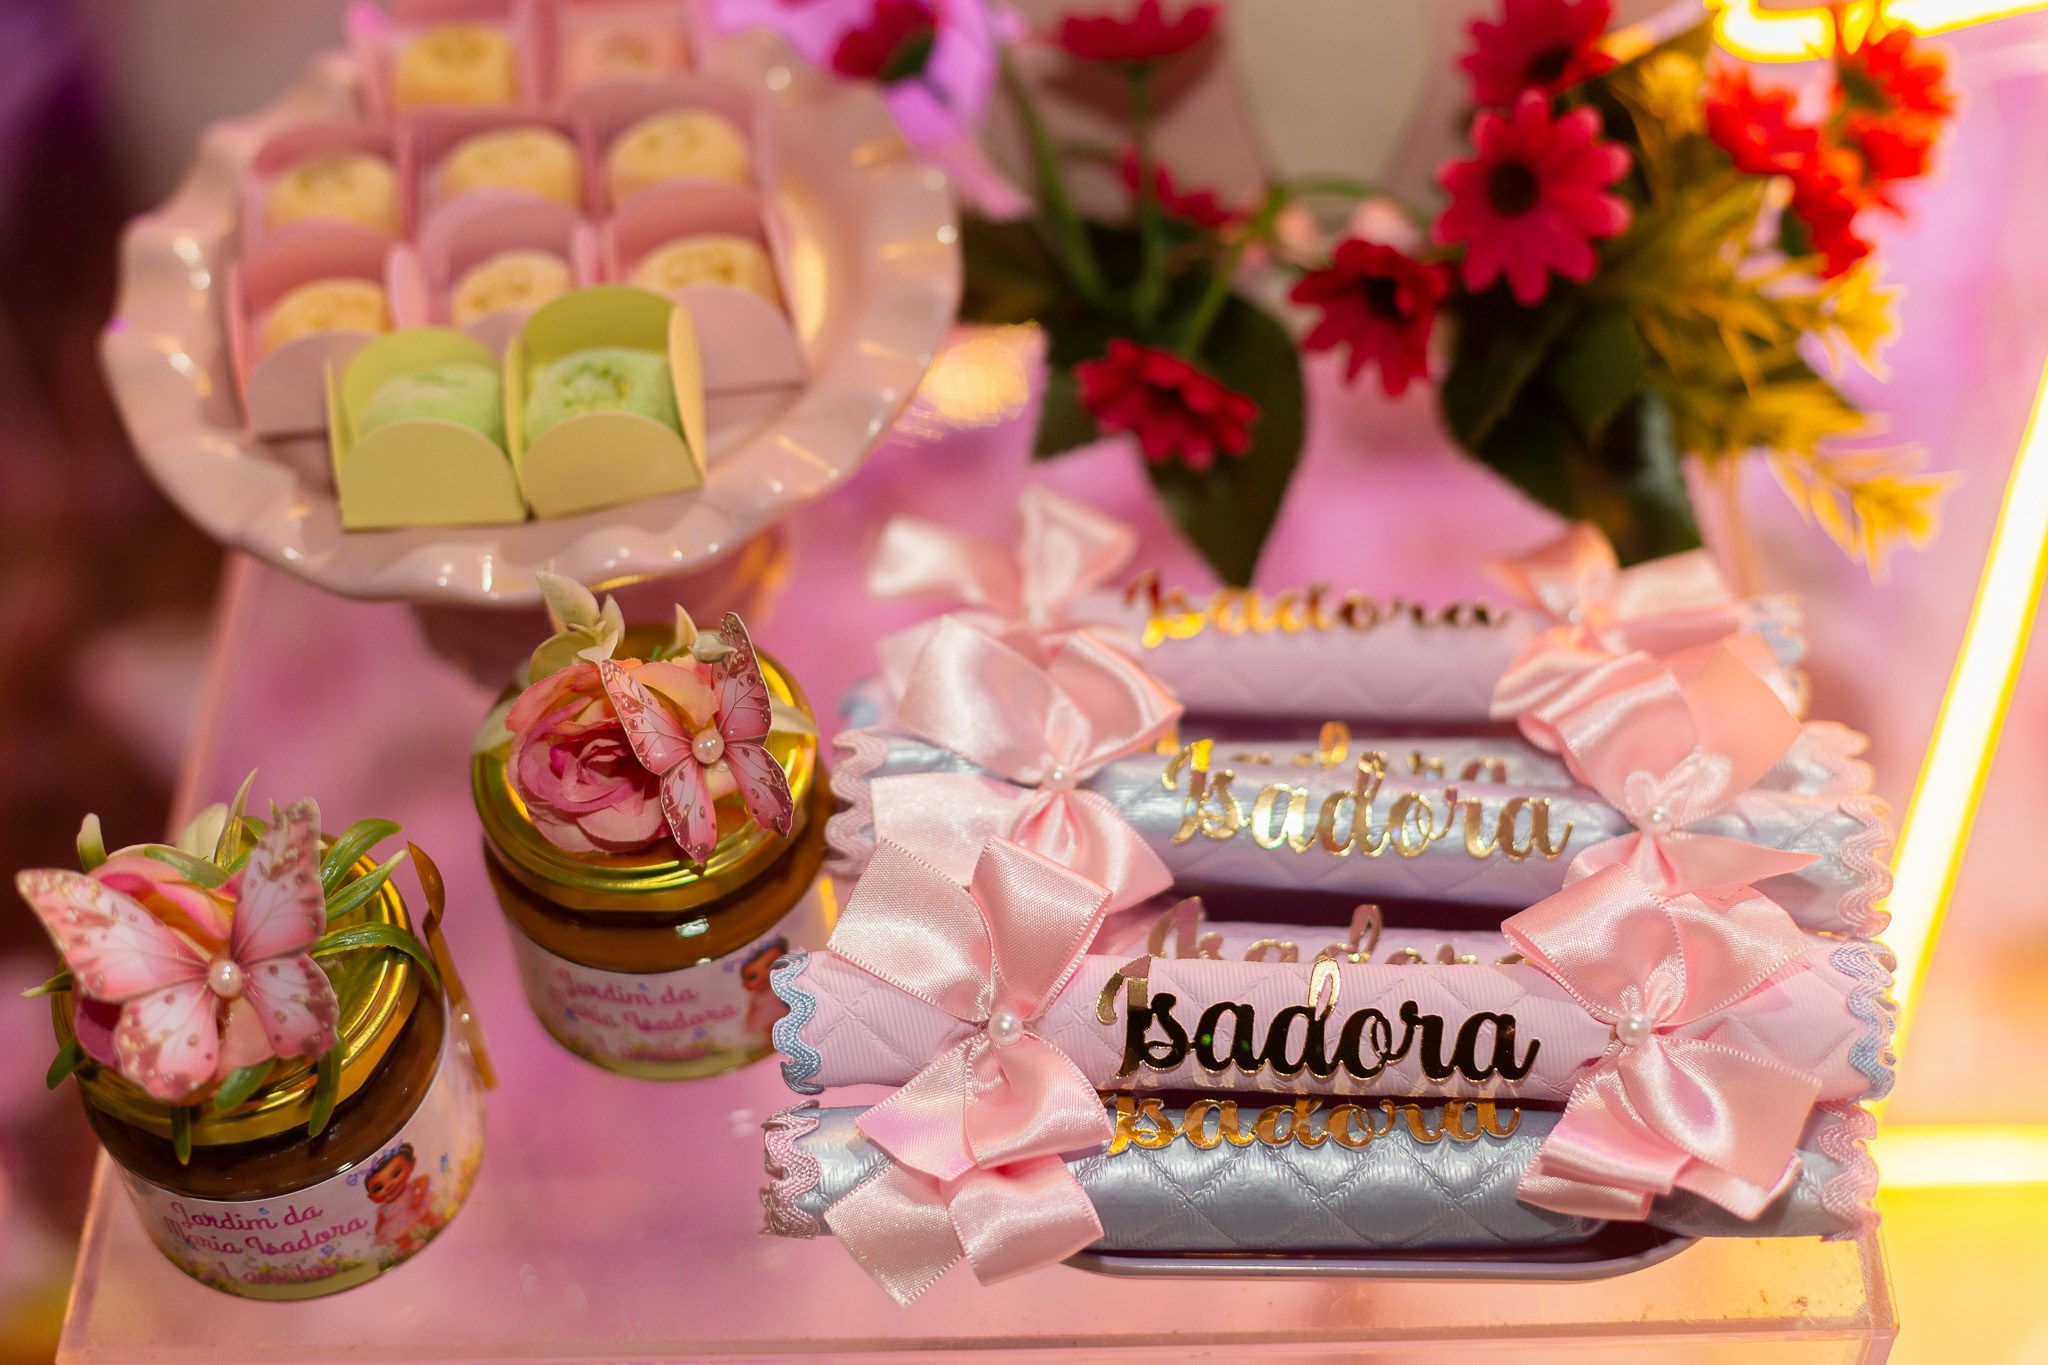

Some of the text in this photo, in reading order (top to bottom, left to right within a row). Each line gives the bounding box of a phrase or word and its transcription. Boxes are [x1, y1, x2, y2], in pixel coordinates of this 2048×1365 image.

[1124, 569, 1512, 649] Isadora
[1160, 738, 1575, 862] Isadora
[557, 968, 700, 1007] Jardim da
[1096, 954, 1541, 1082] Isadora
[163, 1213, 368, 1256] Maria Isadora
[170, 1201, 325, 1232] Jardim da
